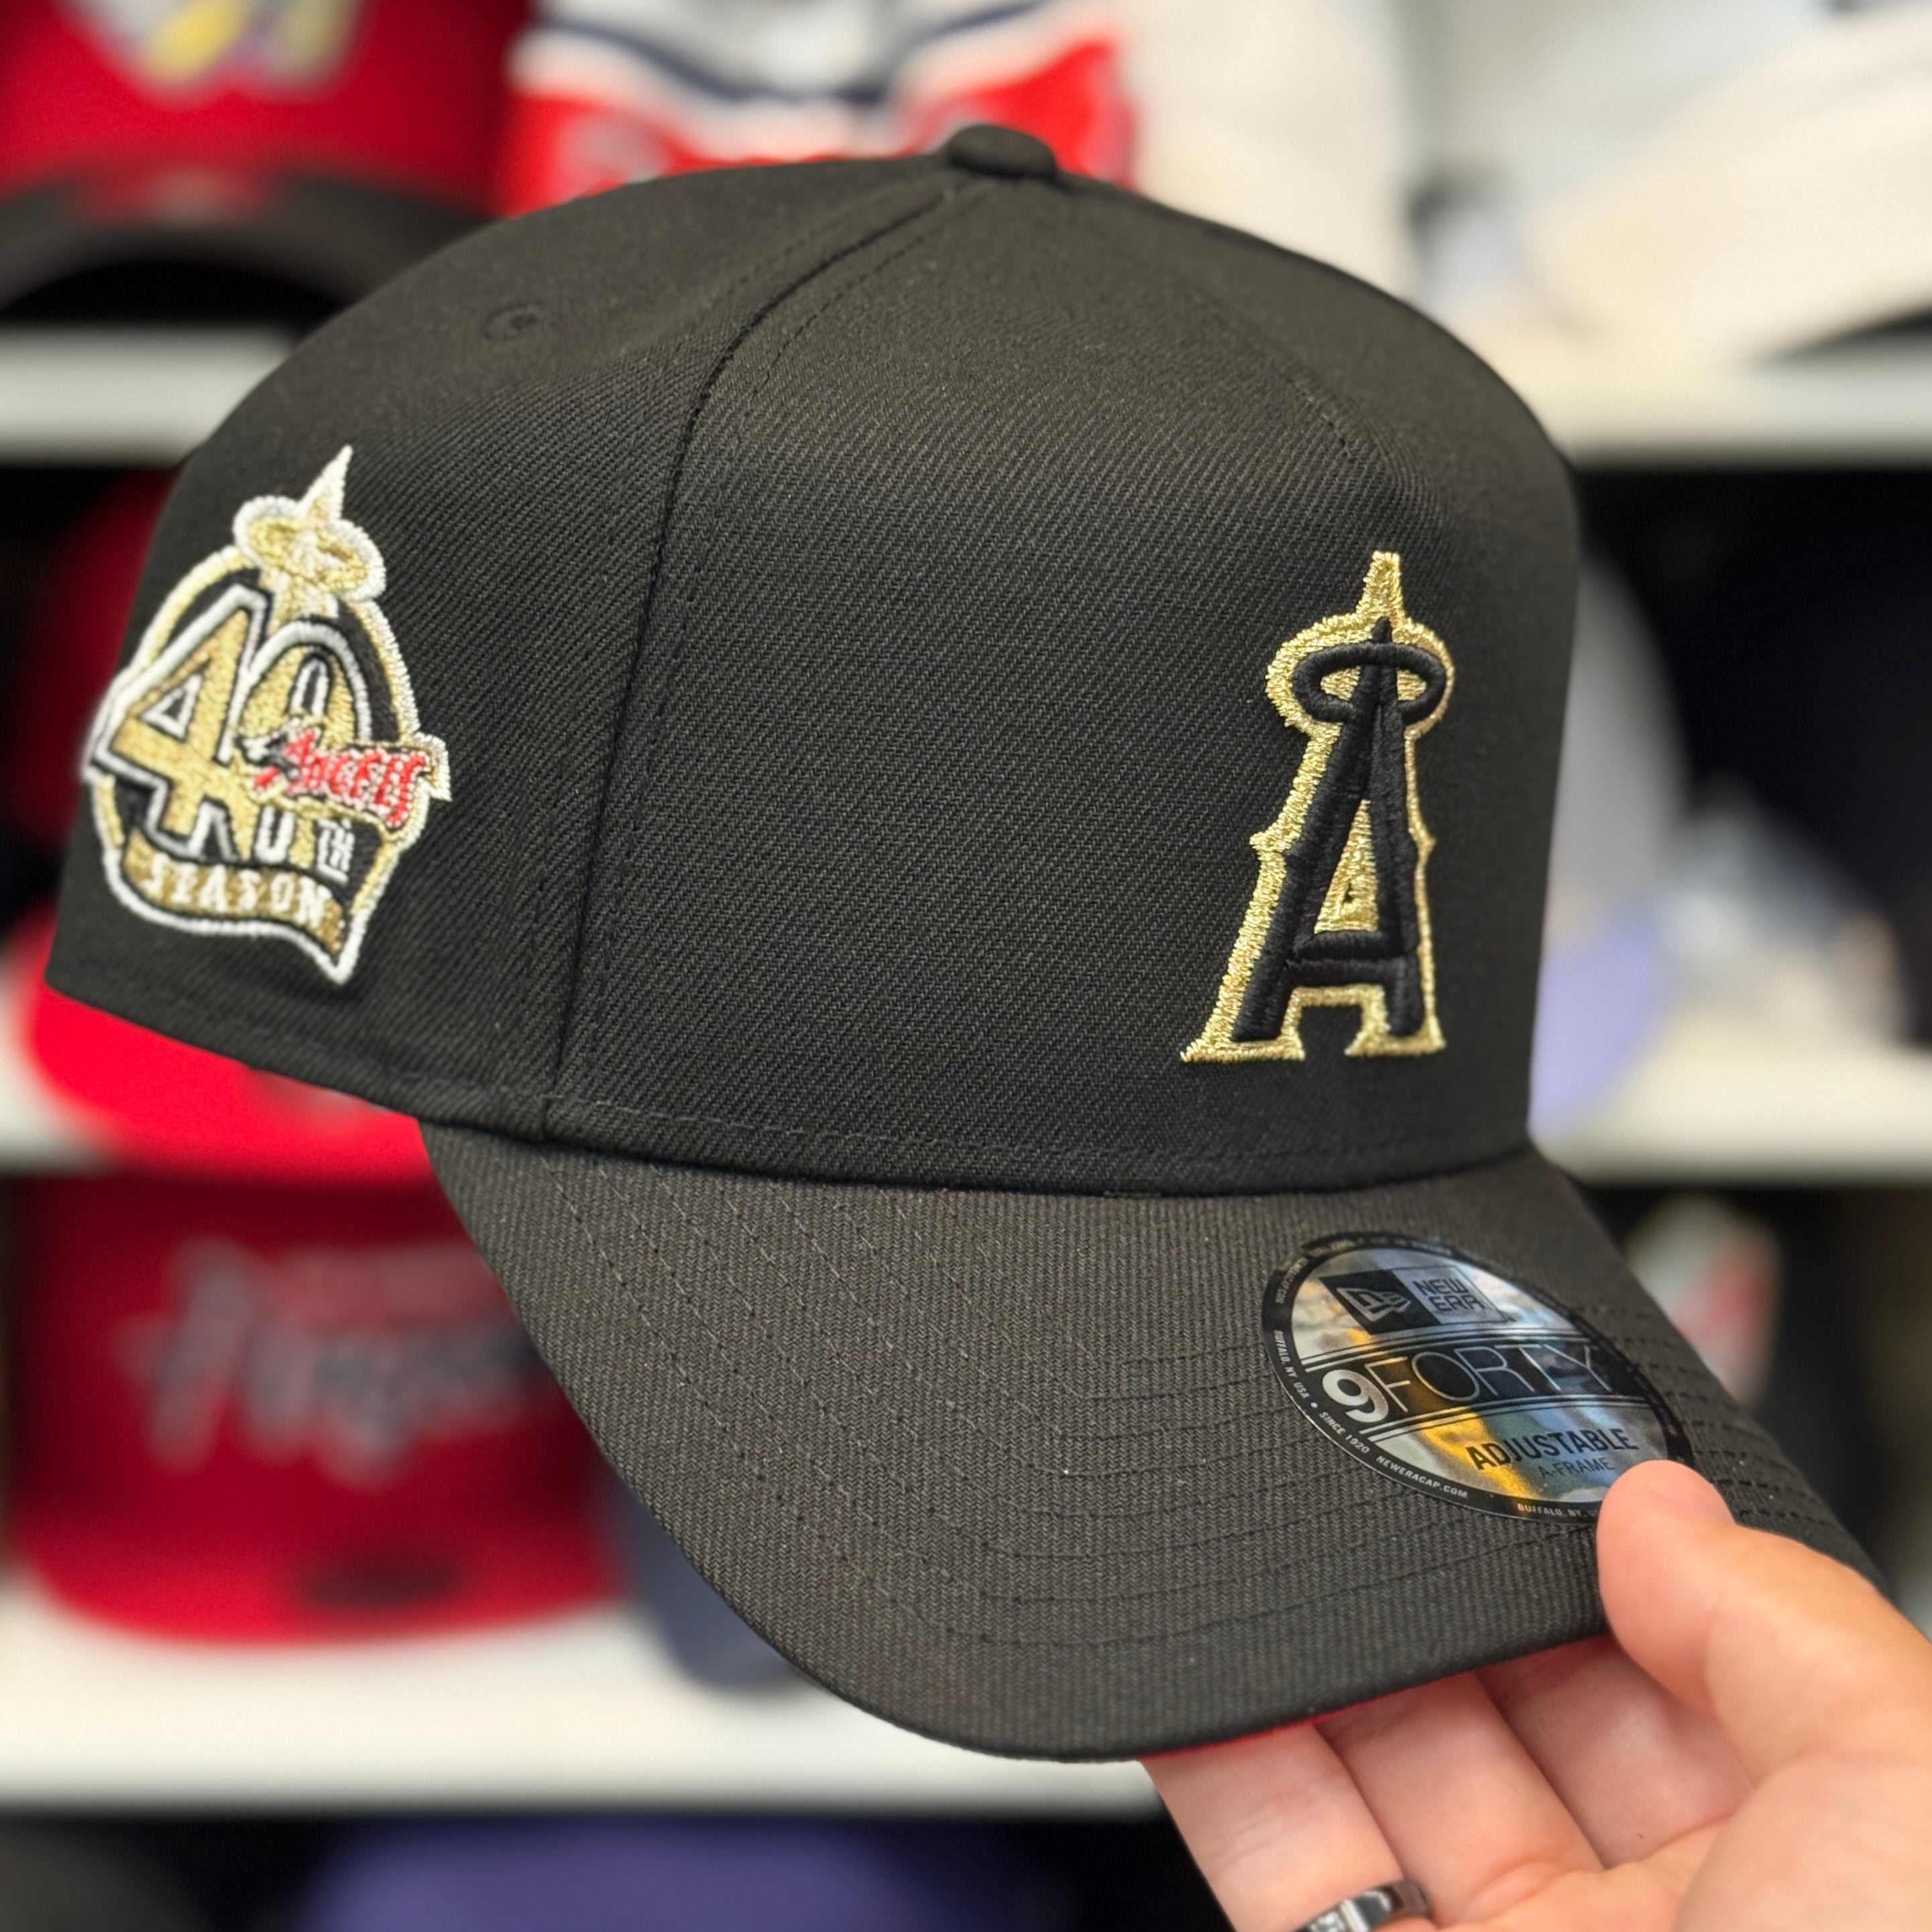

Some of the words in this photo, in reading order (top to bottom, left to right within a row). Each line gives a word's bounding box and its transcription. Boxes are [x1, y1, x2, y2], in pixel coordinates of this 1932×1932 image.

[141, 852, 333, 928] SEASON
[1413, 1279, 1467, 1296] NEW
[1429, 1296, 1485, 1312] ERA
[1322, 1343, 1611, 1423] 9FORTY
[1284, 1366, 1298, 1378] NY
[1293, 1381, 1310, 1398] USA
[1318, 1411, 1346, 1436] SINCE
[1345, 1434, 1370, 1454] 1920
[1375, 1455, 1469, 1499] NEWERACAP.COM
[1465, 1428, 1640, 1471] ADJUSTABLE
[1538, 1457, 1617, 1478] A-FRAME
